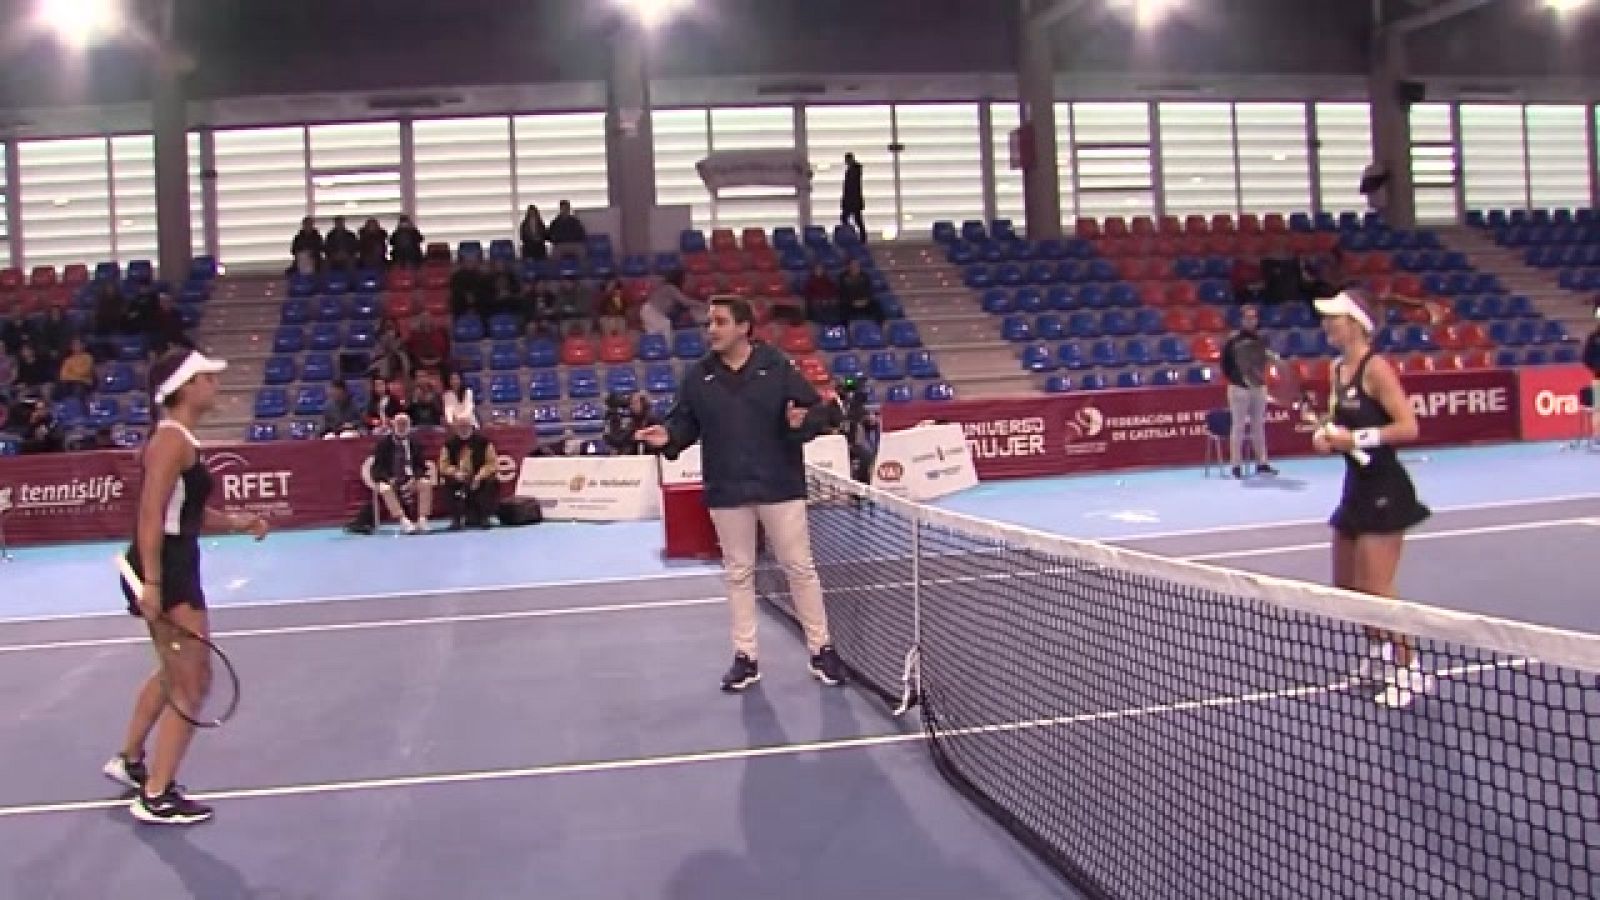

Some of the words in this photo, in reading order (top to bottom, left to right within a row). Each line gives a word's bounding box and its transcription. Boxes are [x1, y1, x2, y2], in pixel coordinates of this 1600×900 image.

[1409, 387, 1508, 418] APFRE
[1535, 390, 1579, 416] Ora
[20, 475, 124, 504] tennislife
[222, 471, 293, 500] RFET
